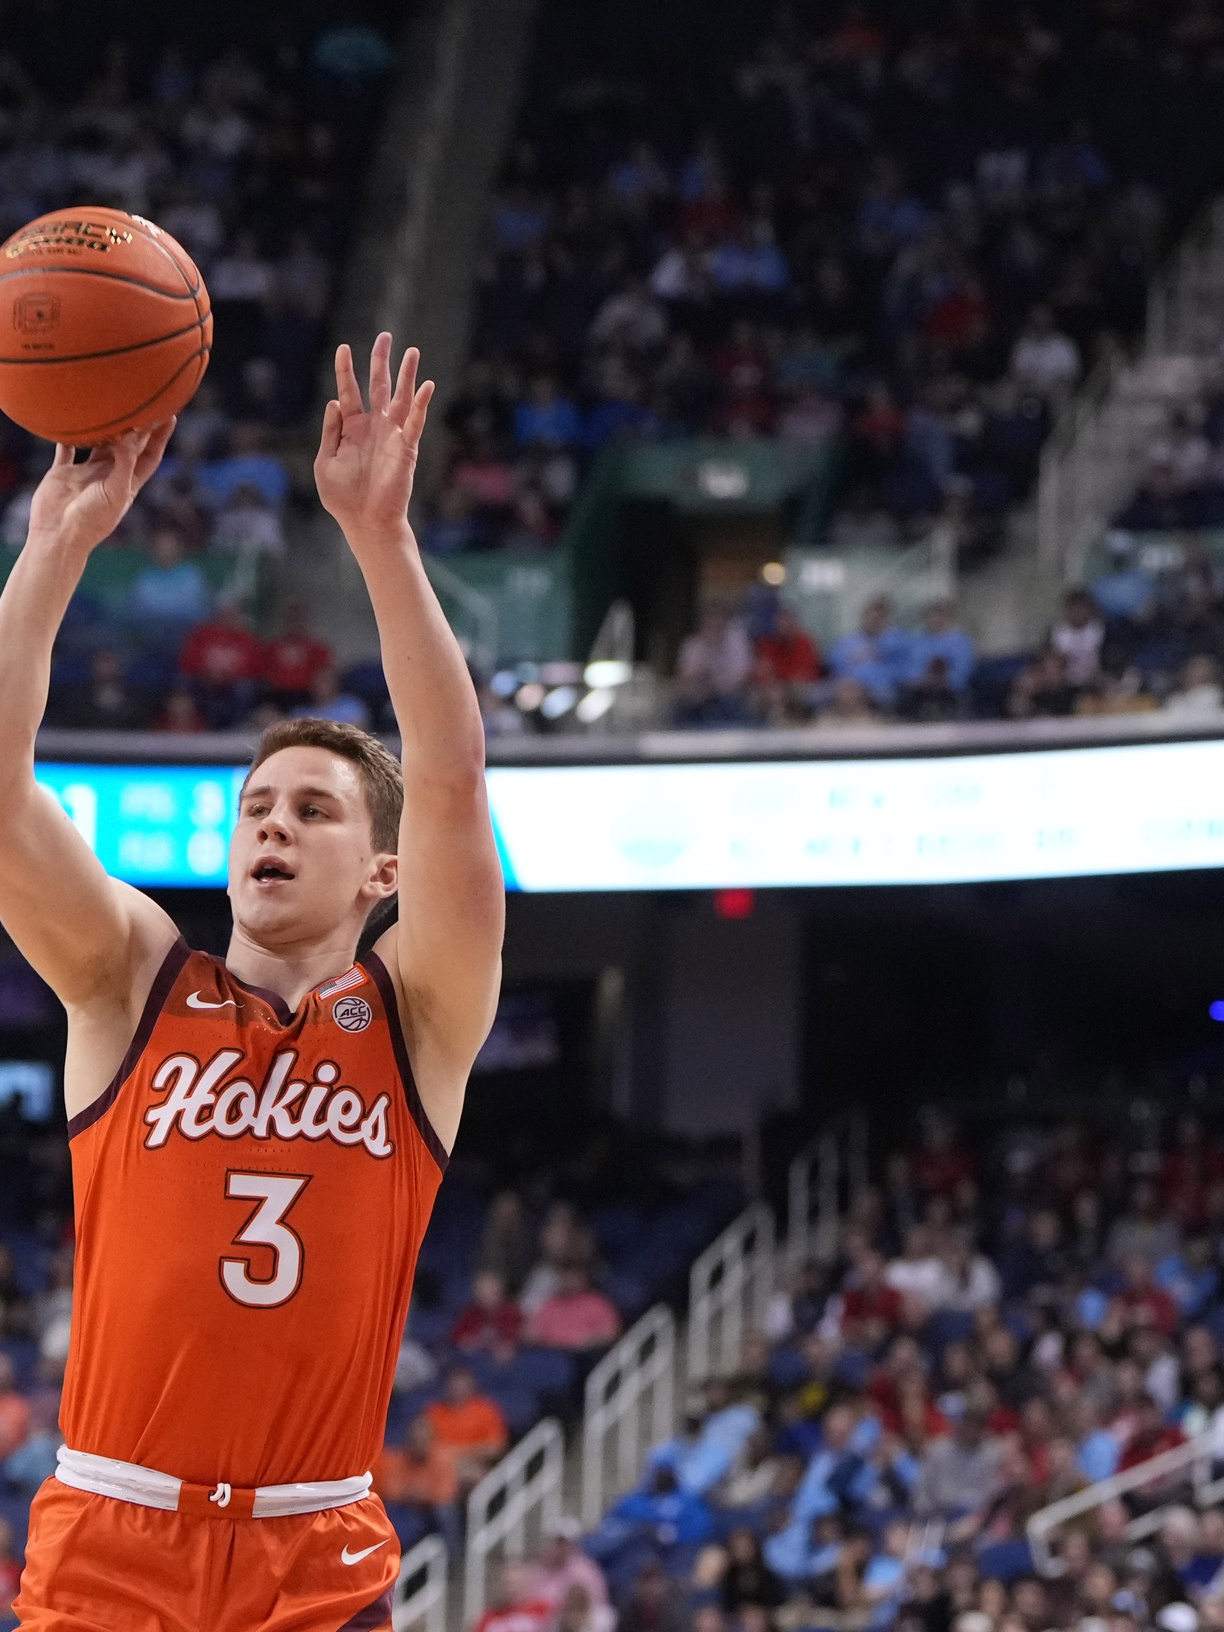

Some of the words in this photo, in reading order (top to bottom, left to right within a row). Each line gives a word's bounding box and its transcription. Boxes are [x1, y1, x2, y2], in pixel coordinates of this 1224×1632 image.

[339, 1004, 367, 1018] ACC
[143, 1046, 395, 1160] Hokies
[219, 1168, 314, 1310] 3
